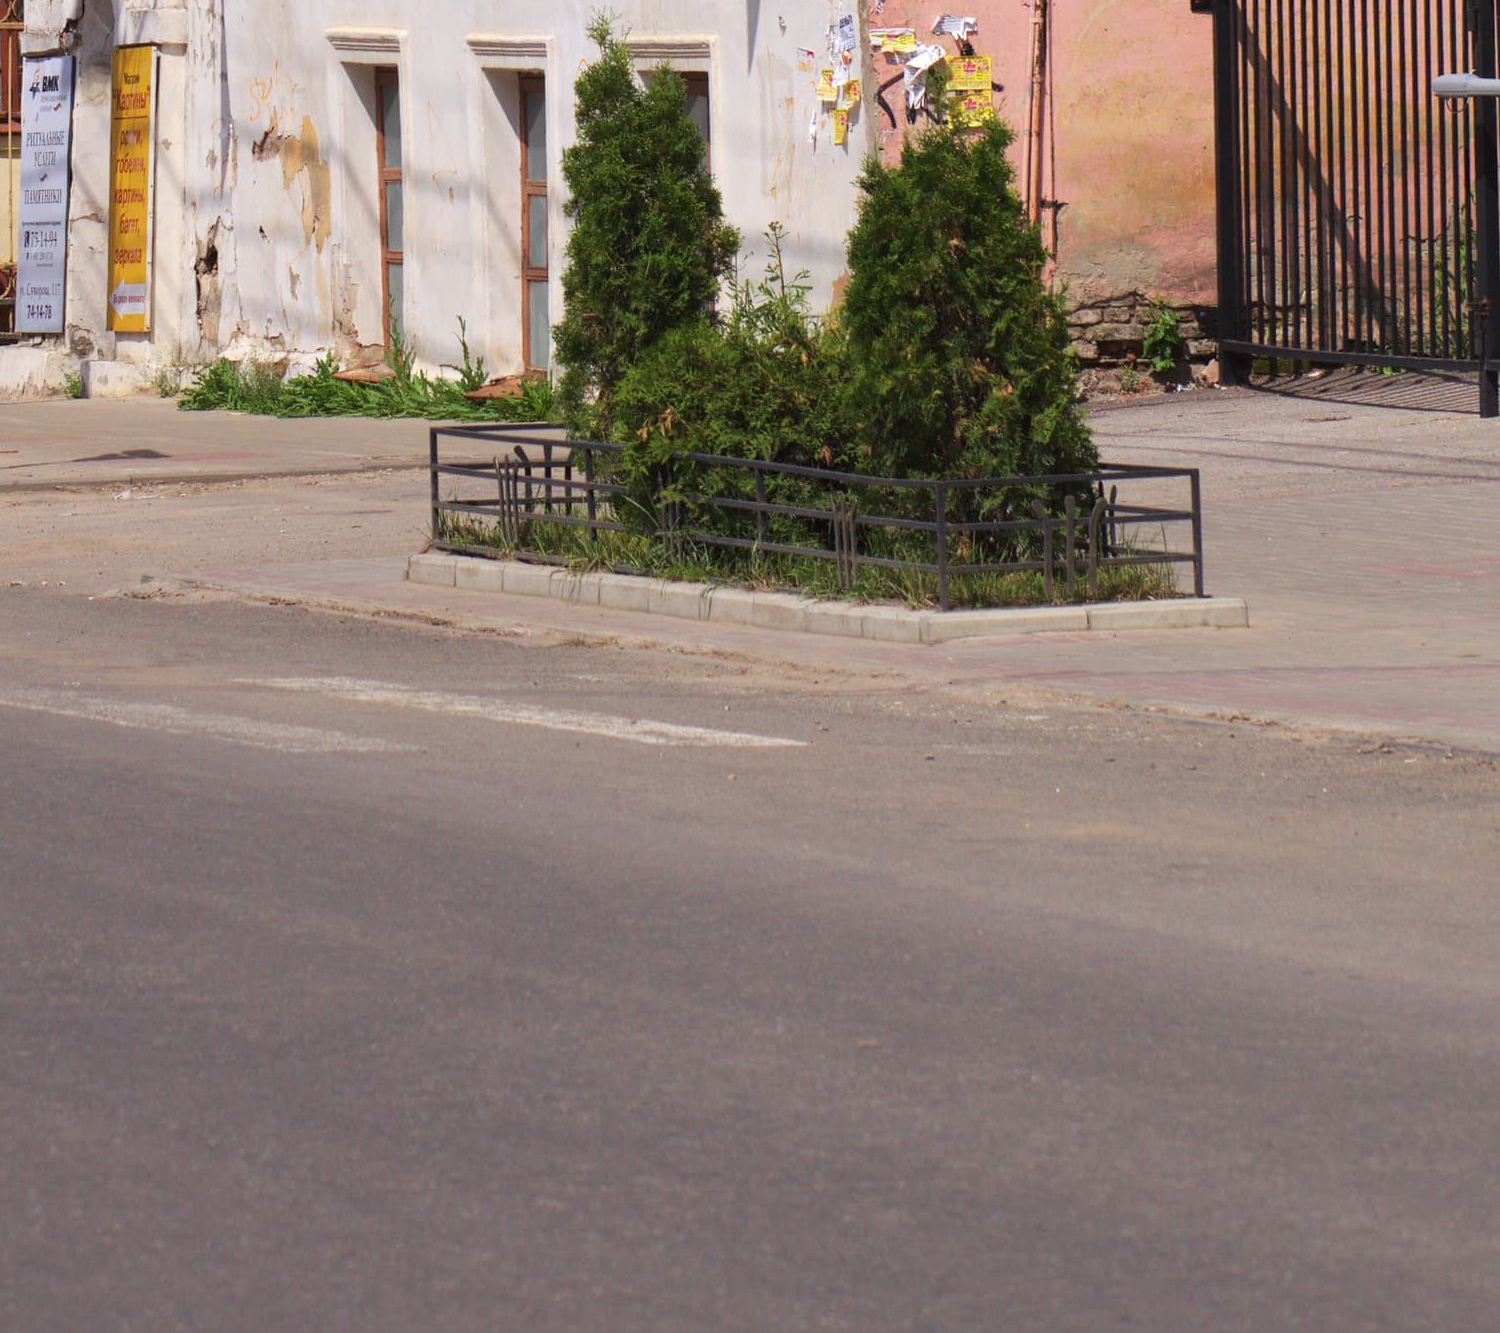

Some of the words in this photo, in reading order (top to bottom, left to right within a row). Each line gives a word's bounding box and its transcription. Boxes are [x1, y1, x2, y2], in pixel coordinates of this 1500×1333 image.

[42, 76, 60, 92] ВМК
[26, 131, 65, 147] РИТУАЛЬНЫЕ
[34, 151, 56, 167] УСЛУГИ
[24, 189, 62, 205] ПАМЯТНИКИ
[115, 248, 142, 269] зеркала
